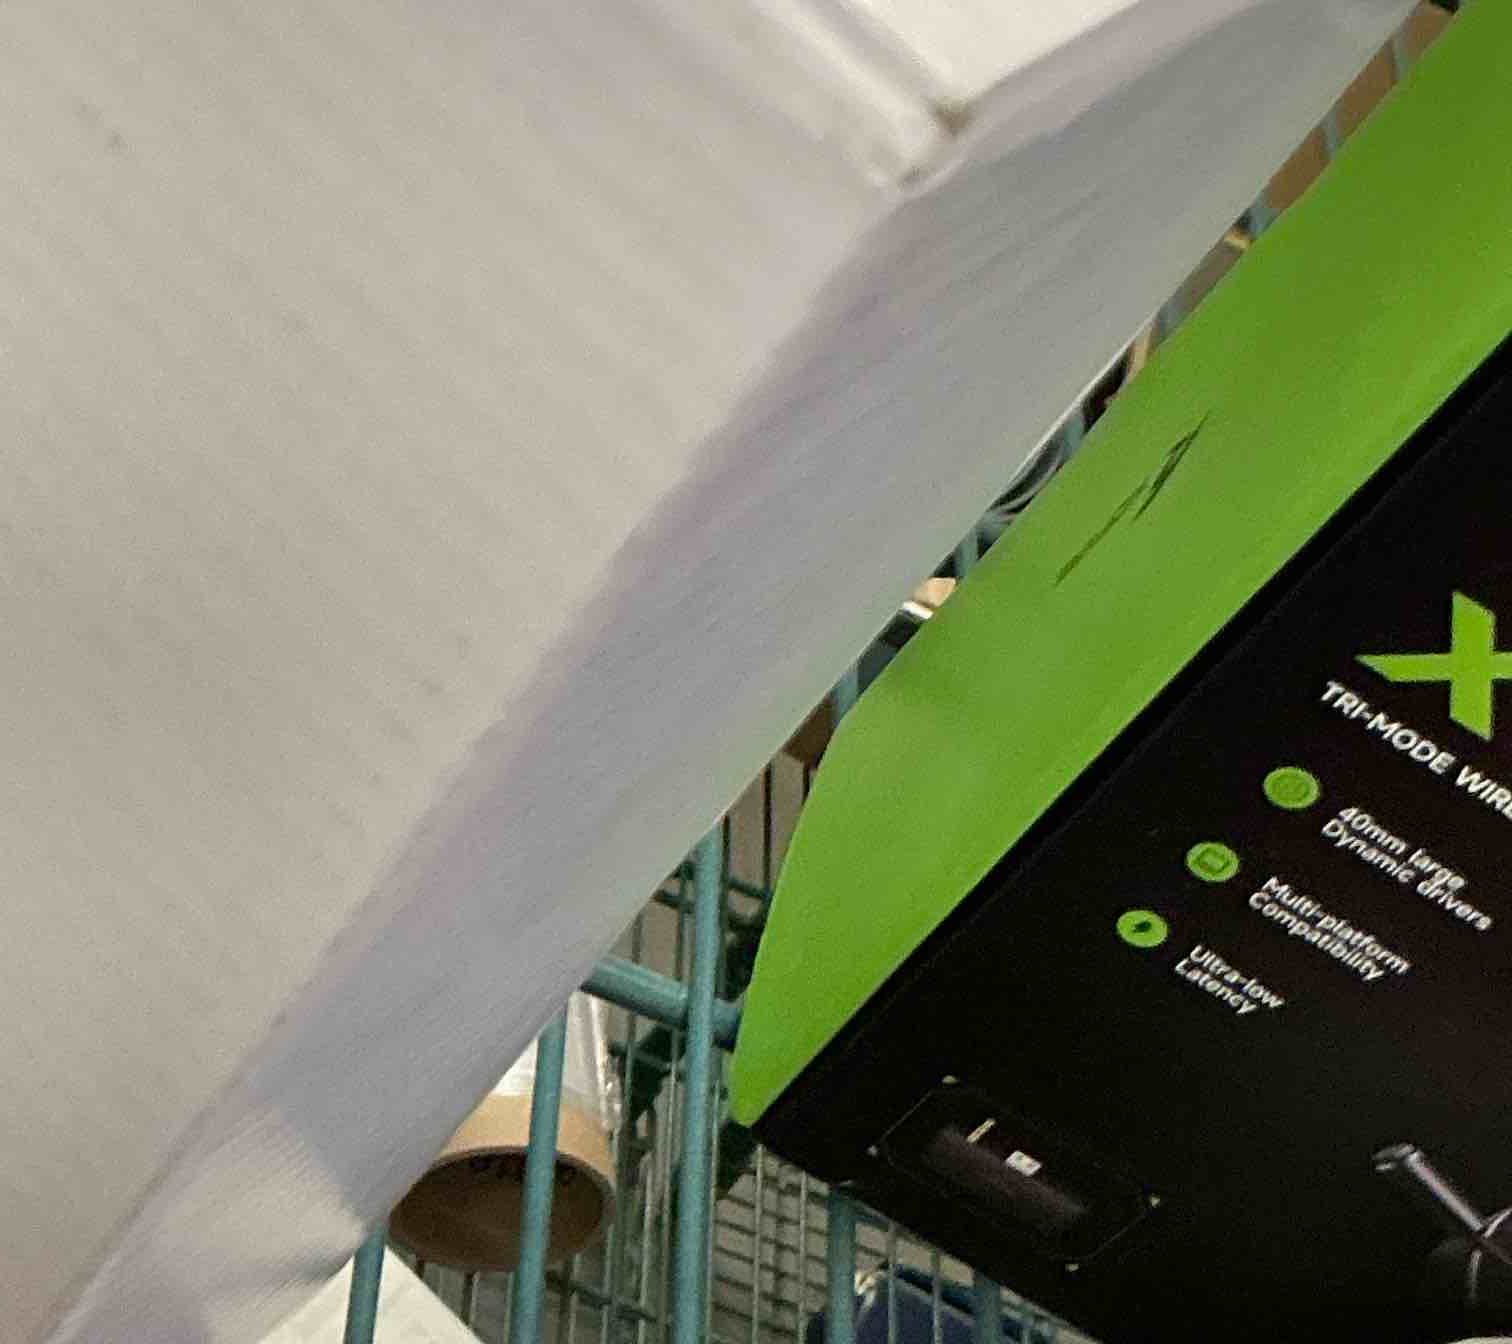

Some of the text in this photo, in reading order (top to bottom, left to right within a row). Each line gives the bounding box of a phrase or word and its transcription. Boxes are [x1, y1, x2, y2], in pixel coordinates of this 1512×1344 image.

[1321, 679, 1457, 775] TRI-MODE
[1320, 818, 1492, 931] Dynamic drivers
[1338, 807, 1408, 855] 40mm
[1248, 892, 1385, 981] Compatibility
[1261, 876, 1412, 975] Multi-platform
[1174, 958, 1258, 1014] Latency
[1189, 944, 1286, 1008] Ultra-low
